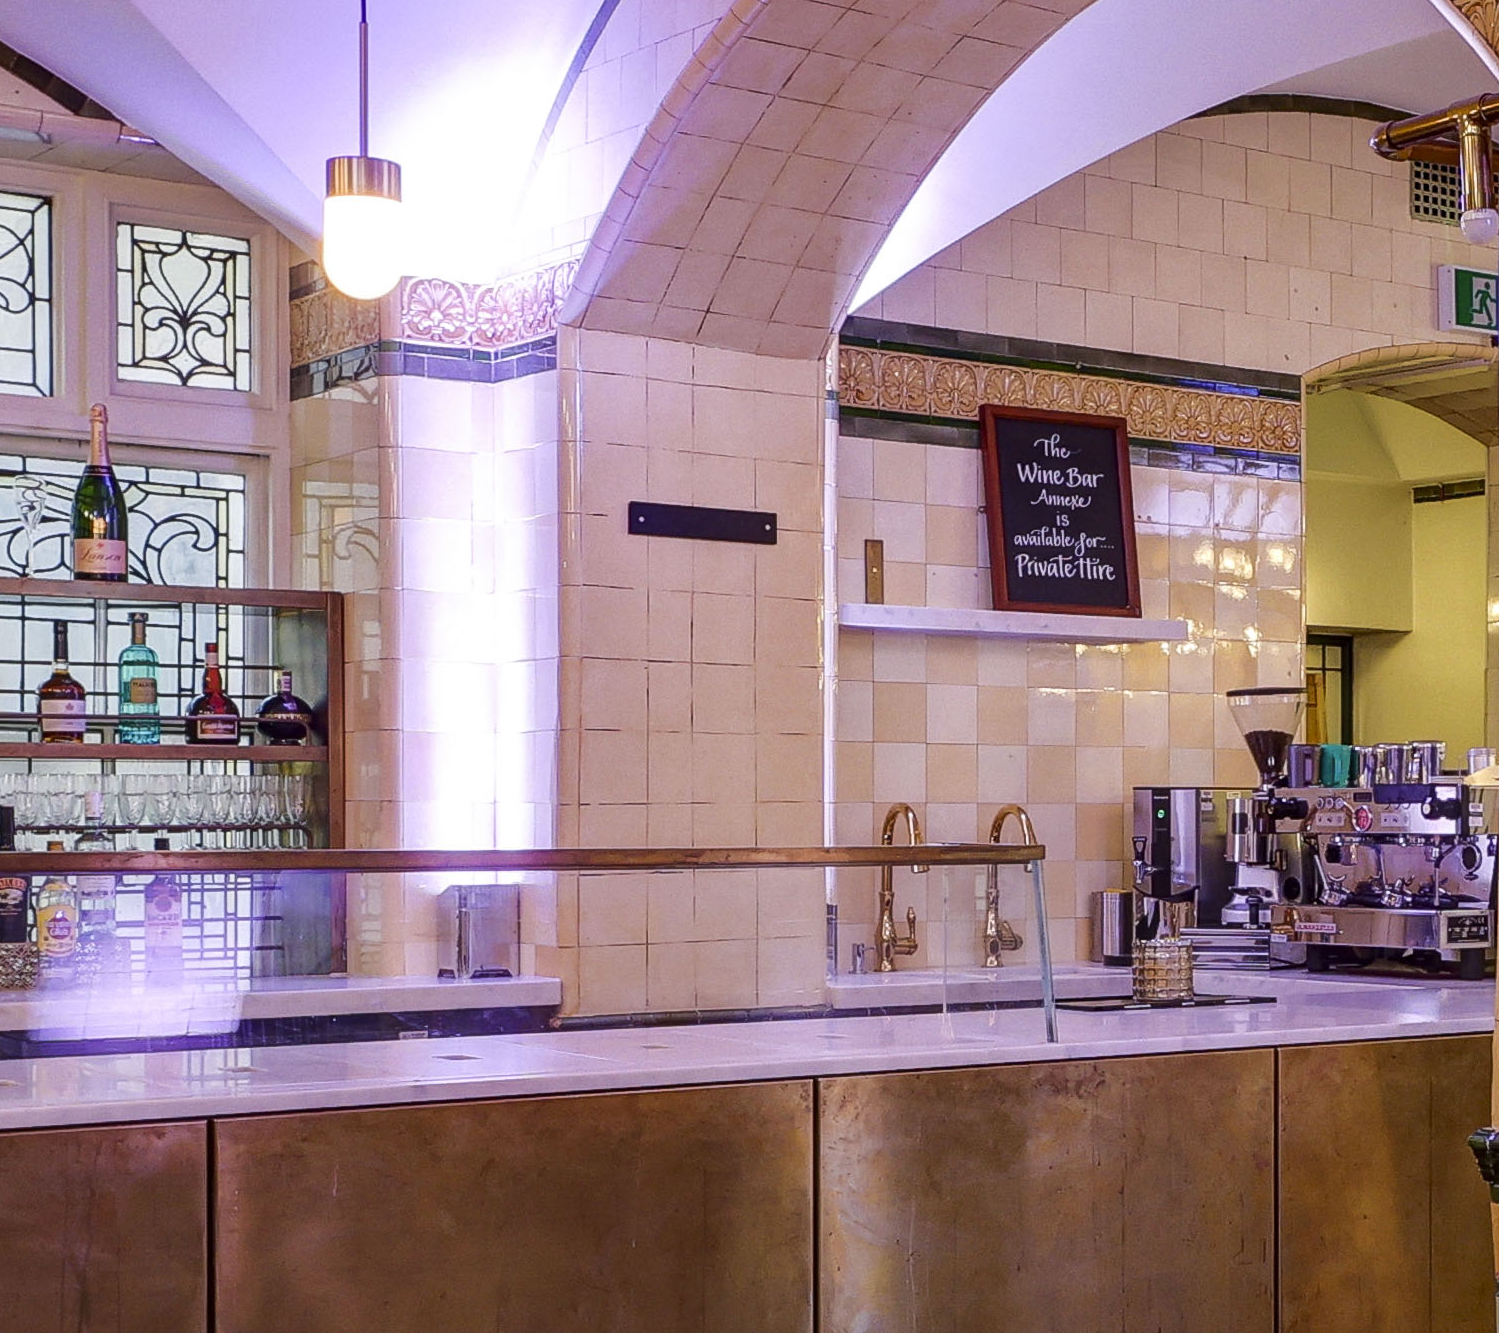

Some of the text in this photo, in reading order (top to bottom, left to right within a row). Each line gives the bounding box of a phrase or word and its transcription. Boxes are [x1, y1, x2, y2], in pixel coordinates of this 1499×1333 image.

[1034, 433, 1072, 459] The
[1017, 462, 1105, 488] Wine Bar
[1031, 488, 1092, 510] Annexe
[1056, 510, 1070, 528] is
[1014, 526, 1076, 548] available
[1015, 553, 1116, 581] Private Hire
